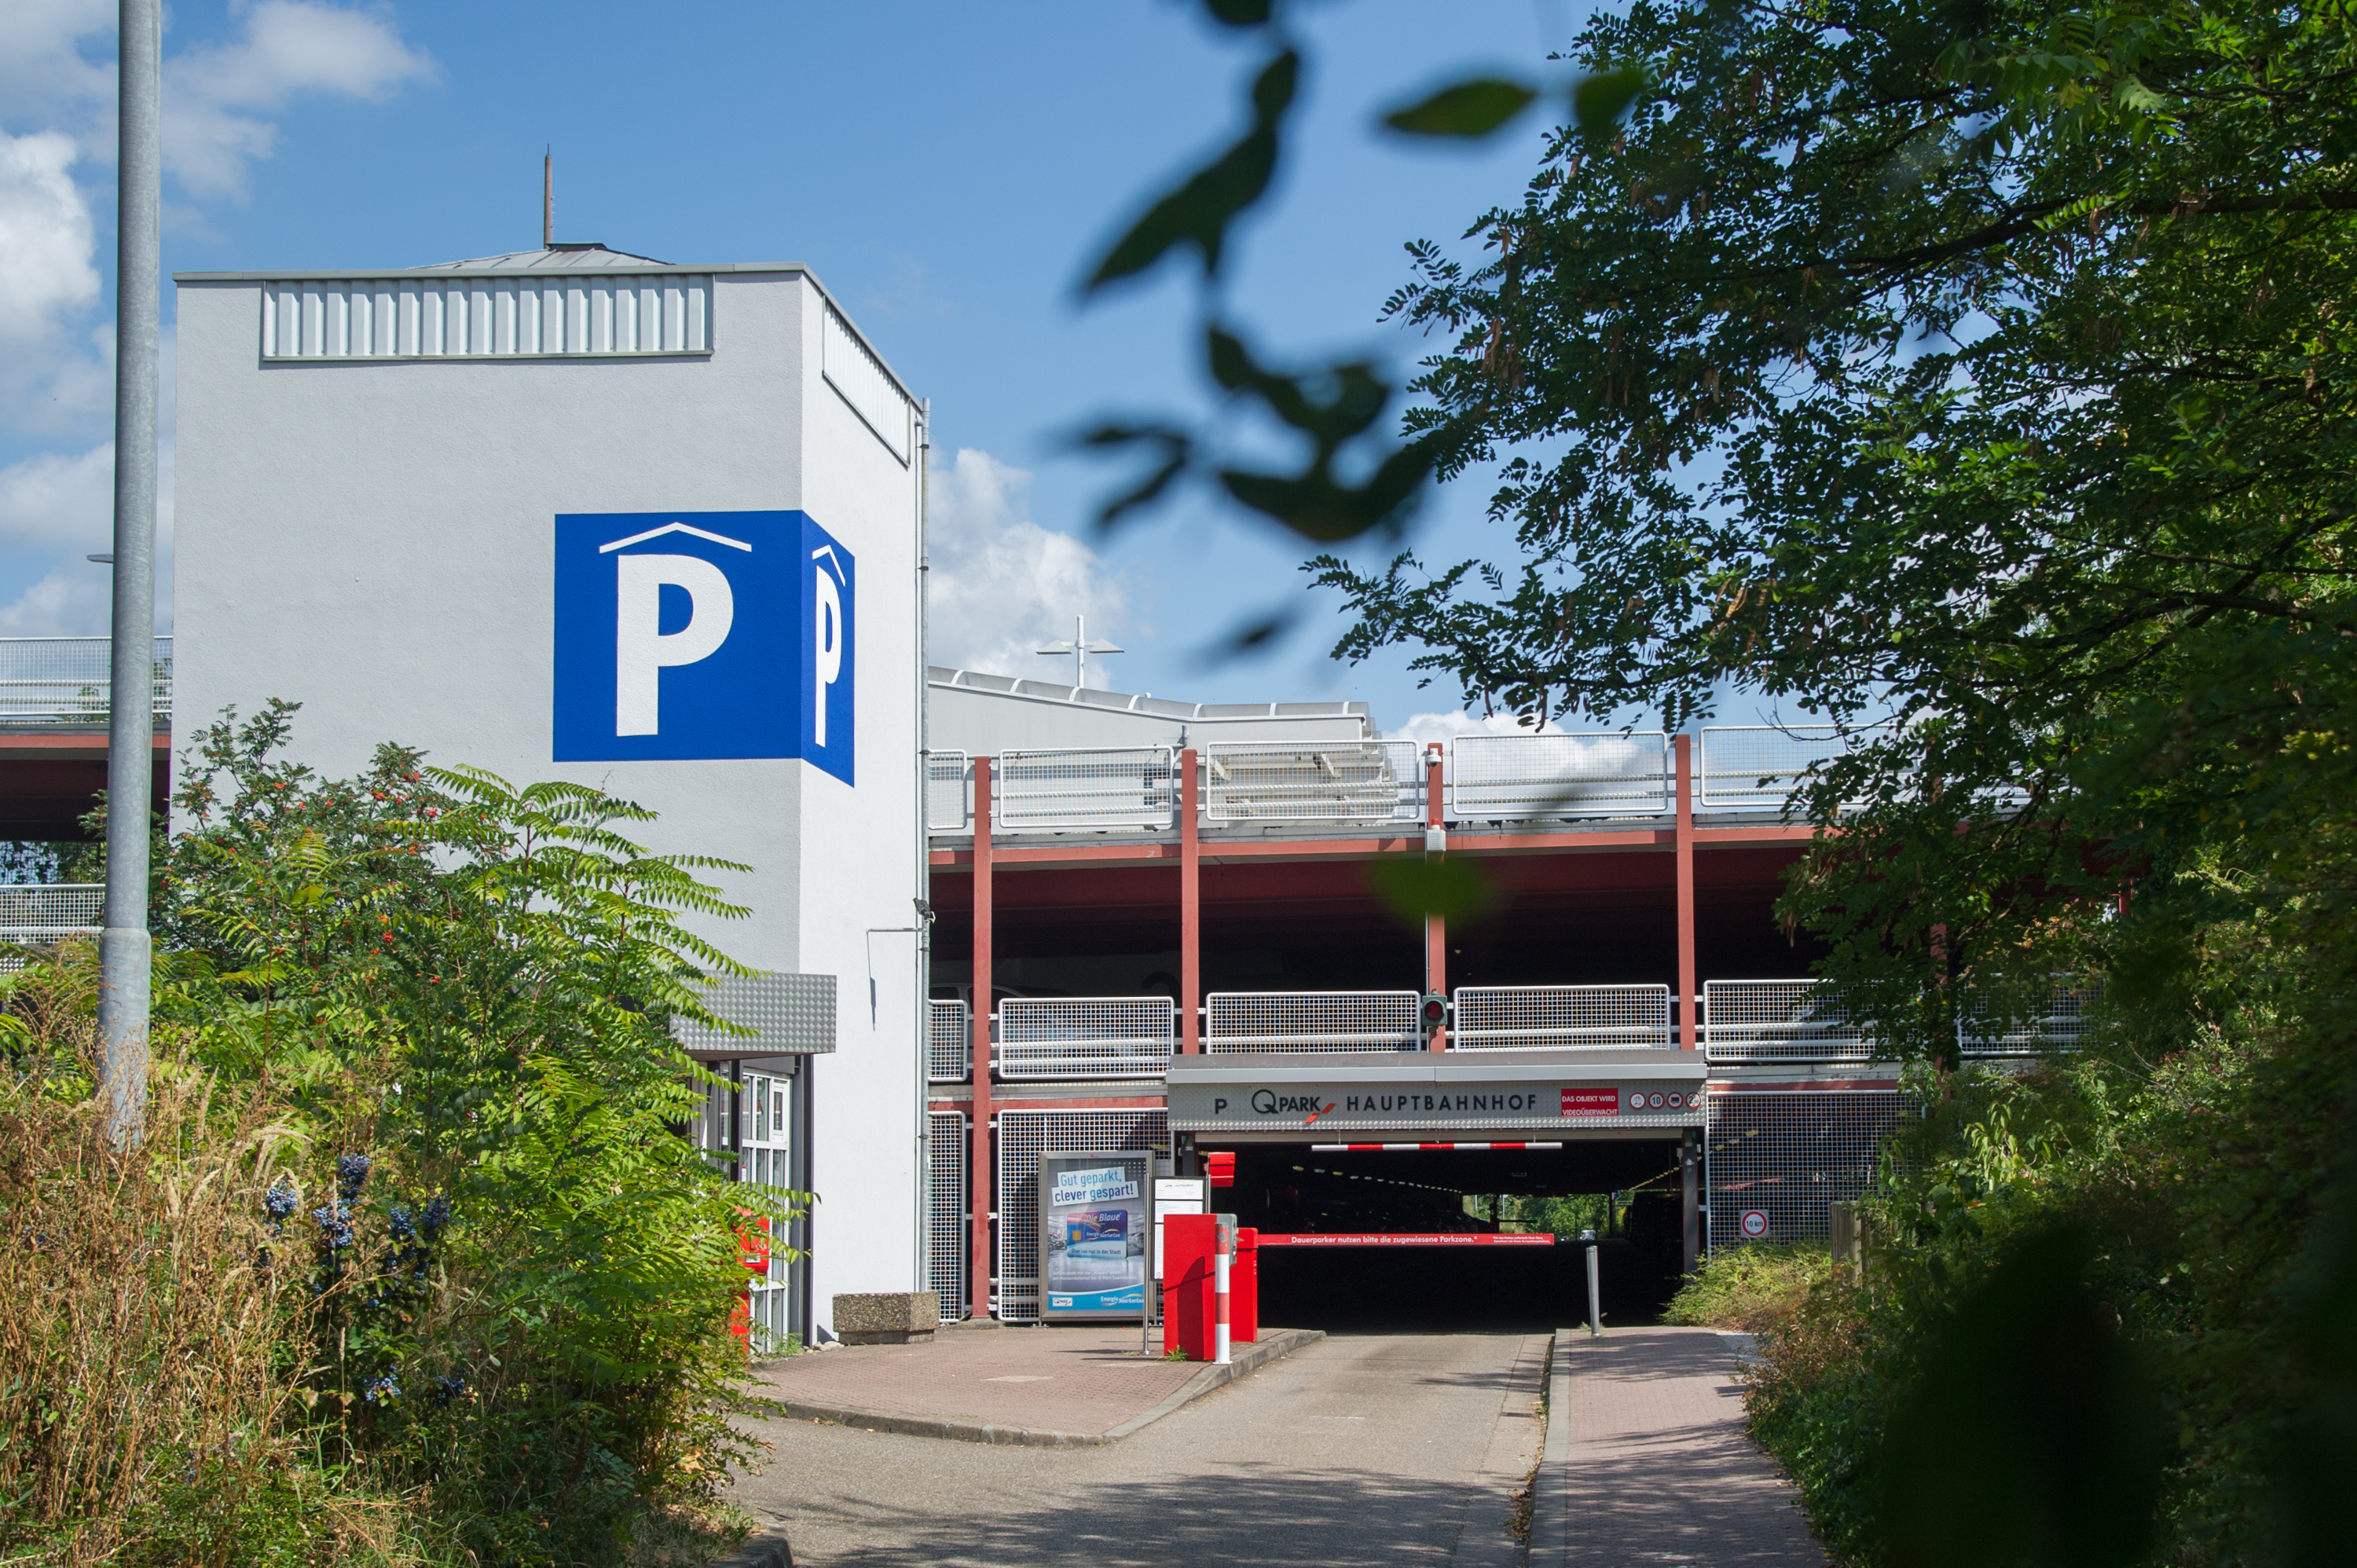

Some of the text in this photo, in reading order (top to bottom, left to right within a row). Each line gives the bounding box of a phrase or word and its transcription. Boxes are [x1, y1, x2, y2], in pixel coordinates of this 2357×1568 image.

[617, 554, 734, 737] P
[815, 565, 842, 748] P
[1215, 1098, 1227, 1114] P
[1346, 1094, 1537, 1112] HAUPTBAHNHOF
[1652, 1096, 1661, 1105] 10
[1562, 1108, 1618, 1116] VIDEOÜBERWACHT
[1061, 1170, 1122, 1187] Gut geparkt,
[1055, 1183, 1134, 1202] clever gespart!
